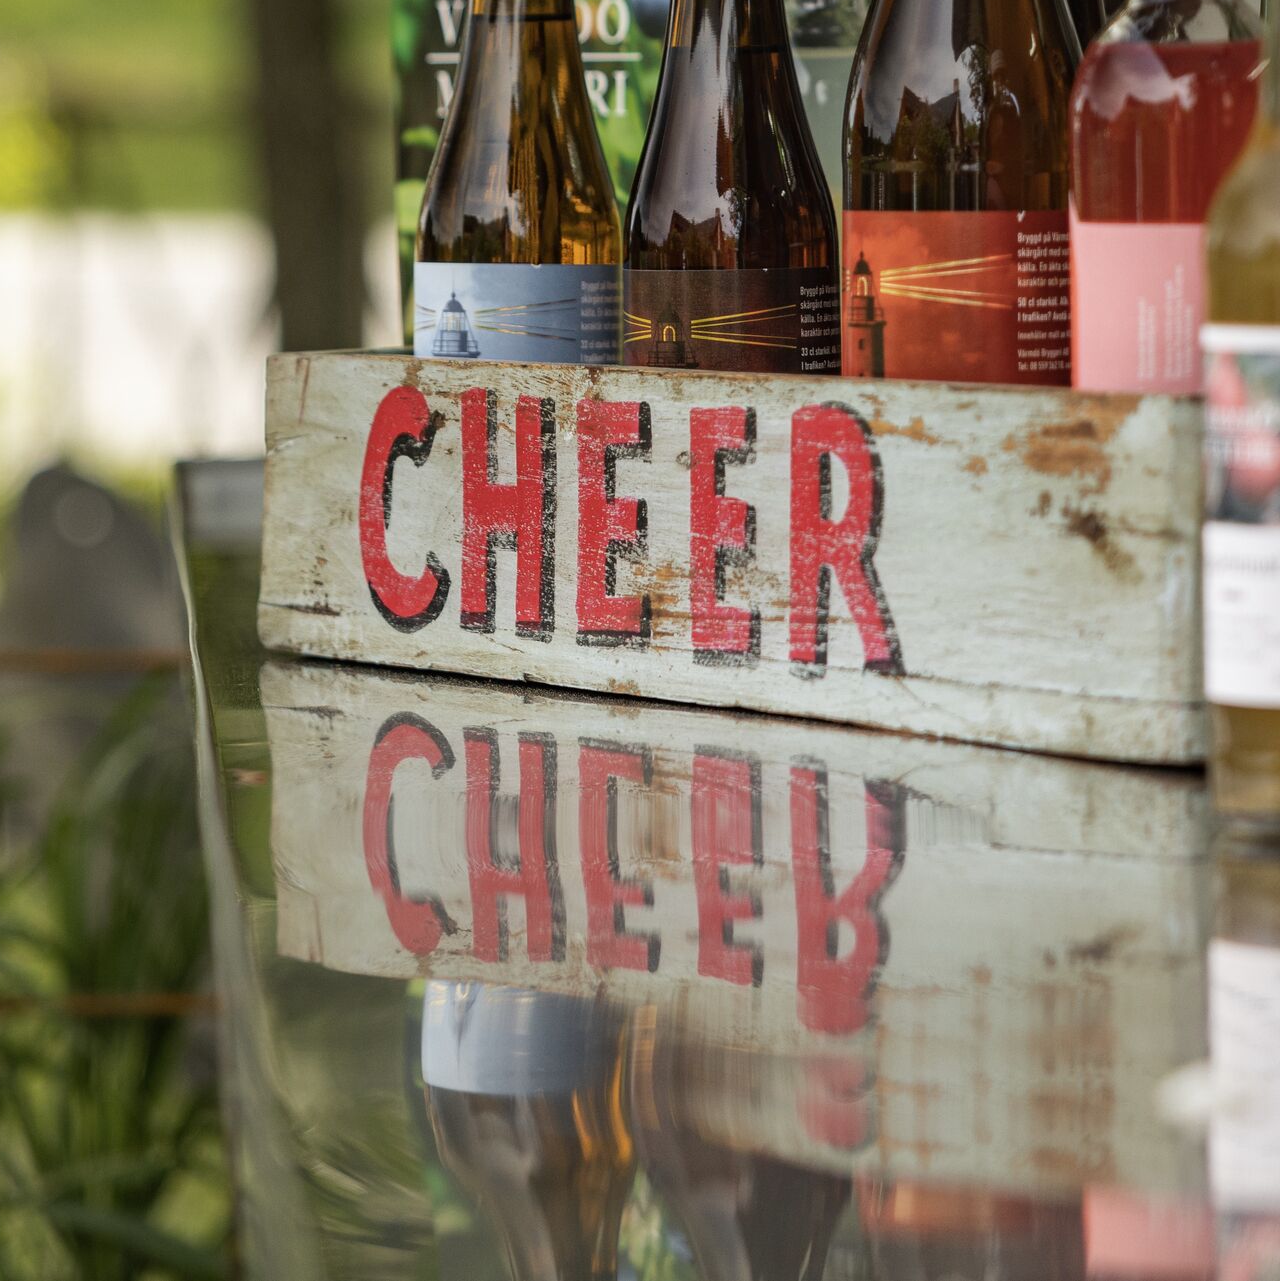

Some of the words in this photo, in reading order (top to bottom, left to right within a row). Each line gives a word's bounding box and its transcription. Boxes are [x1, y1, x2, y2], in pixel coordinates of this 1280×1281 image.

[801, 347, 808, 357] 33
[809, 347, 815, 356] cl
[359, 385, 906, 679] CHEER
